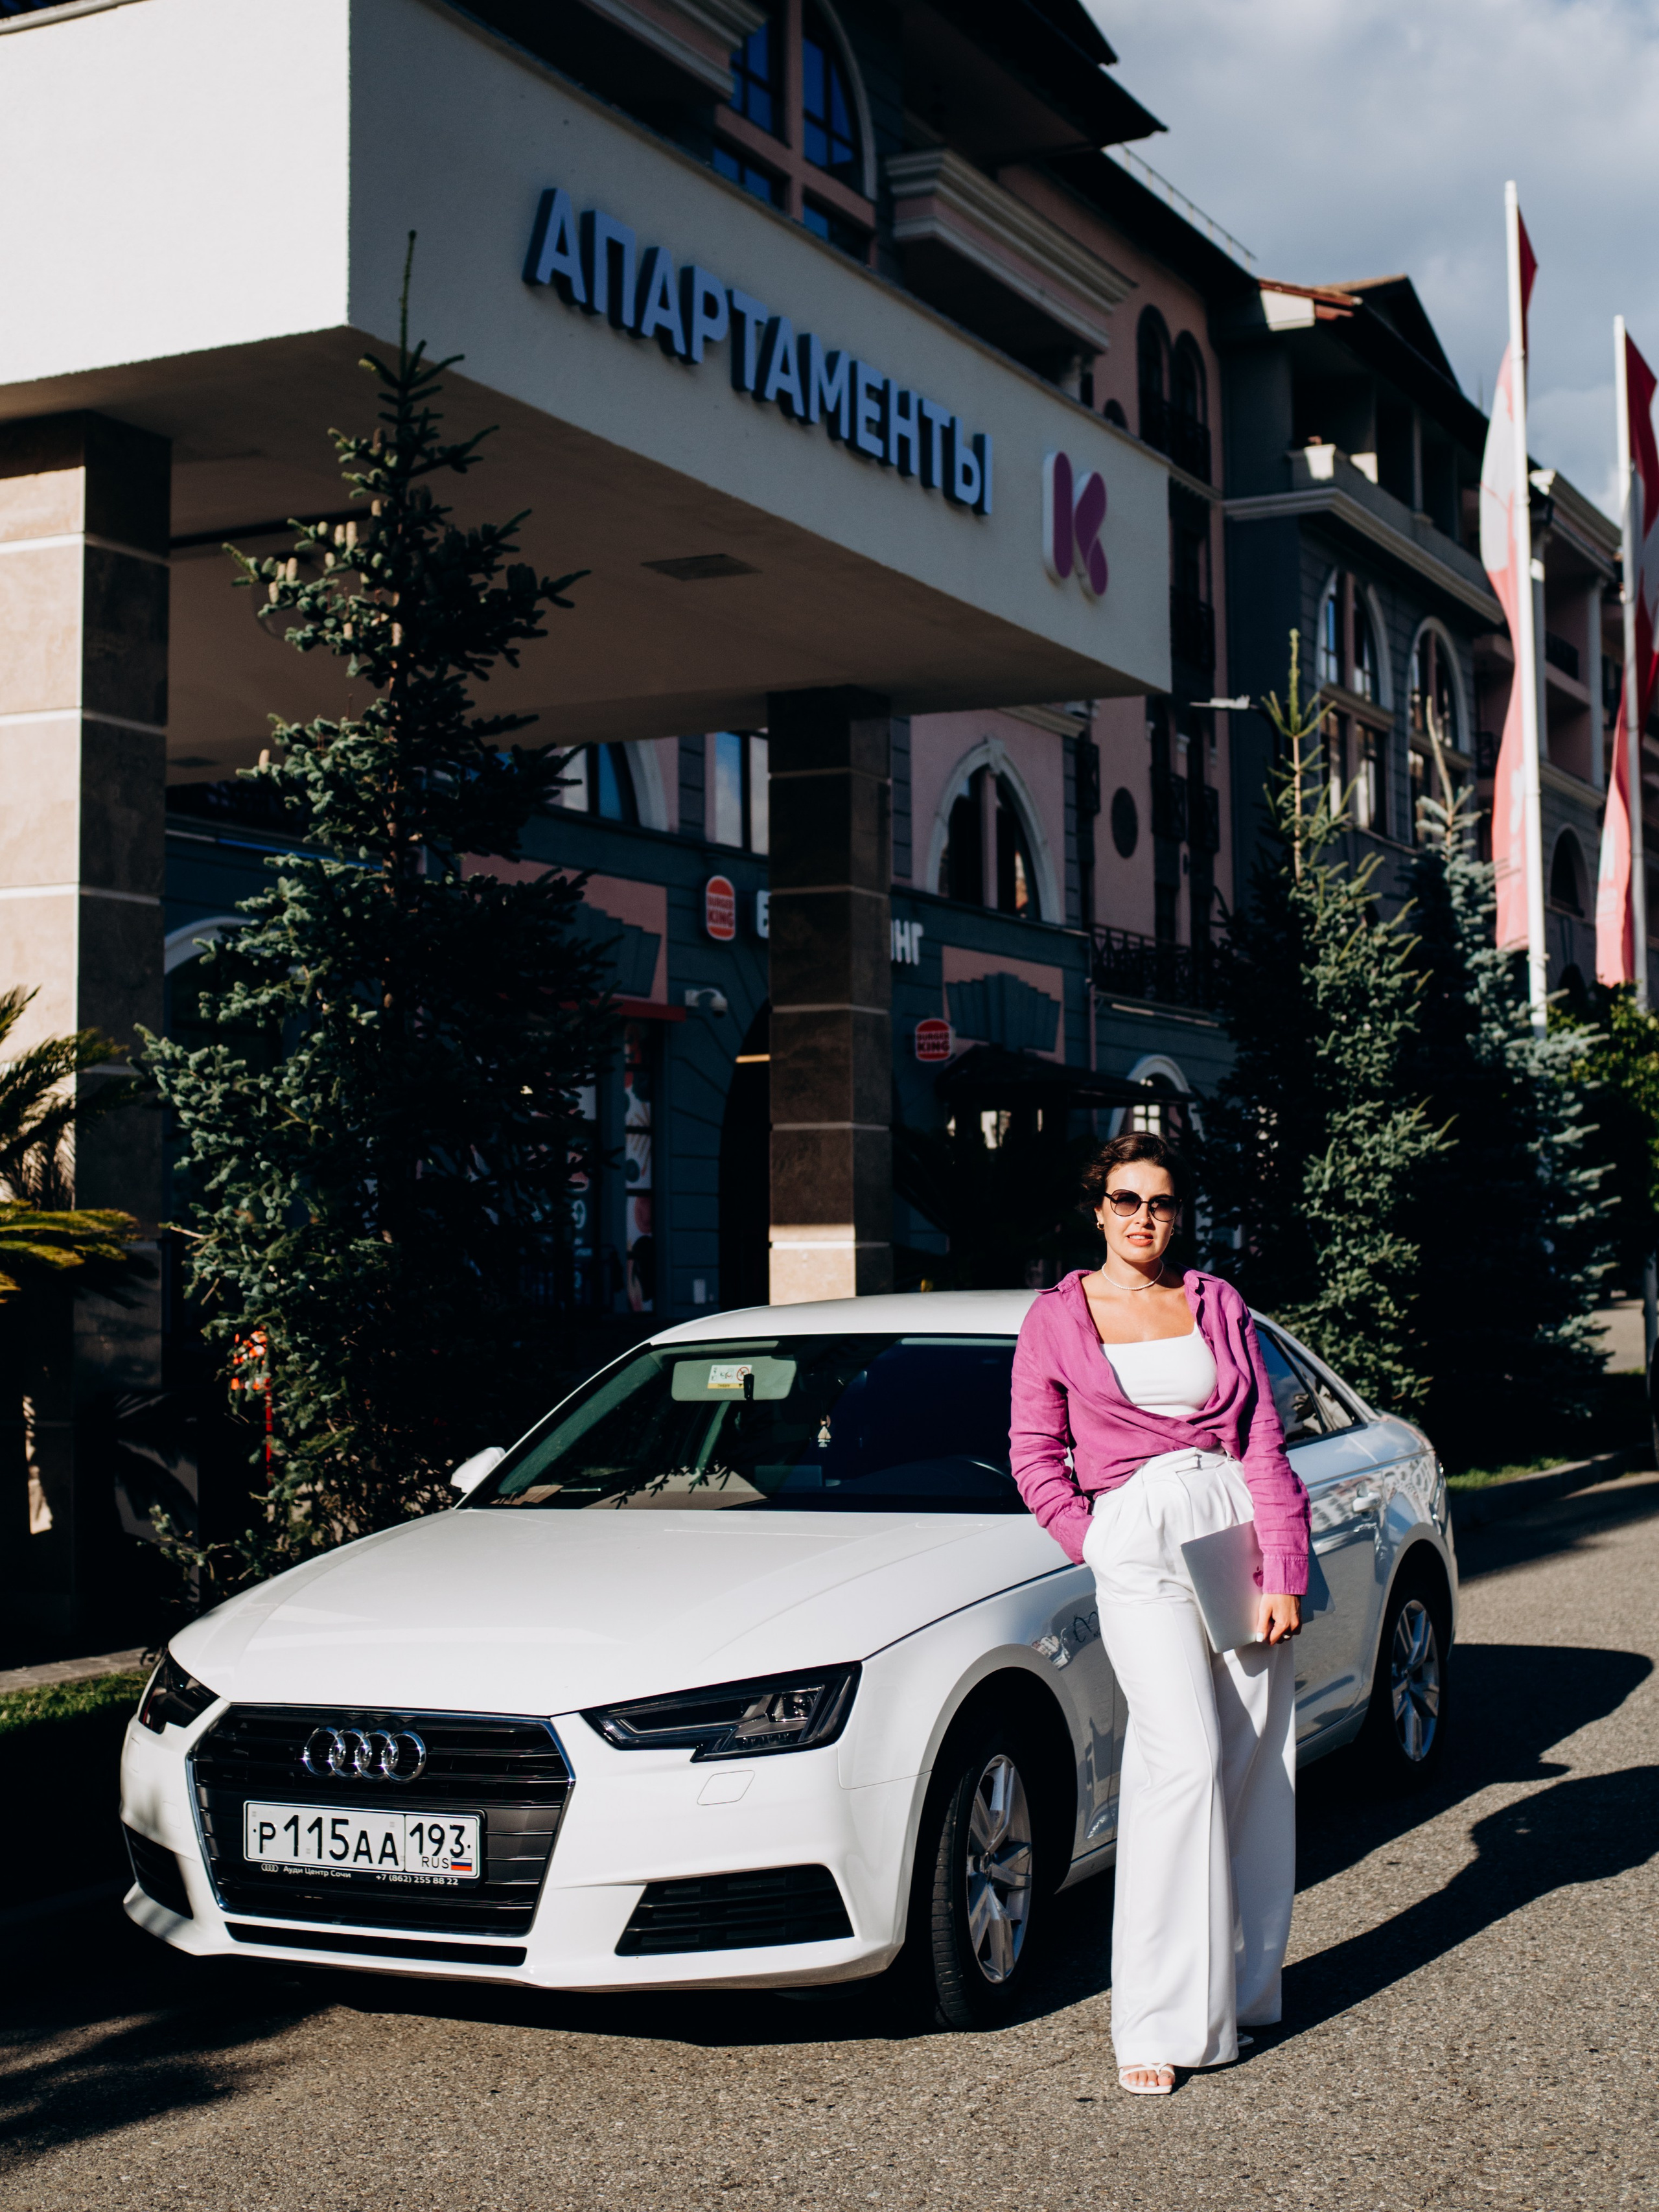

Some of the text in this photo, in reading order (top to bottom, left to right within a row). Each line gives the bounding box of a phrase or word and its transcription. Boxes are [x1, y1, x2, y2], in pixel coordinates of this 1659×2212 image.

[522, 188, 992, 515] АПАРТАМЕНТЫ
[707, 909, 734, 927] KING
[917, 1032, 949, 1041] BURGER
[917, 1041, 949, 1051] KING
[409, 1822, 465, 1858] 193
[422, 1856, 449, 1869] RUS
[283, 1865, 352, 1878] Ауди Центр Сочи
[389, 1874, 412, 1883] (862)
